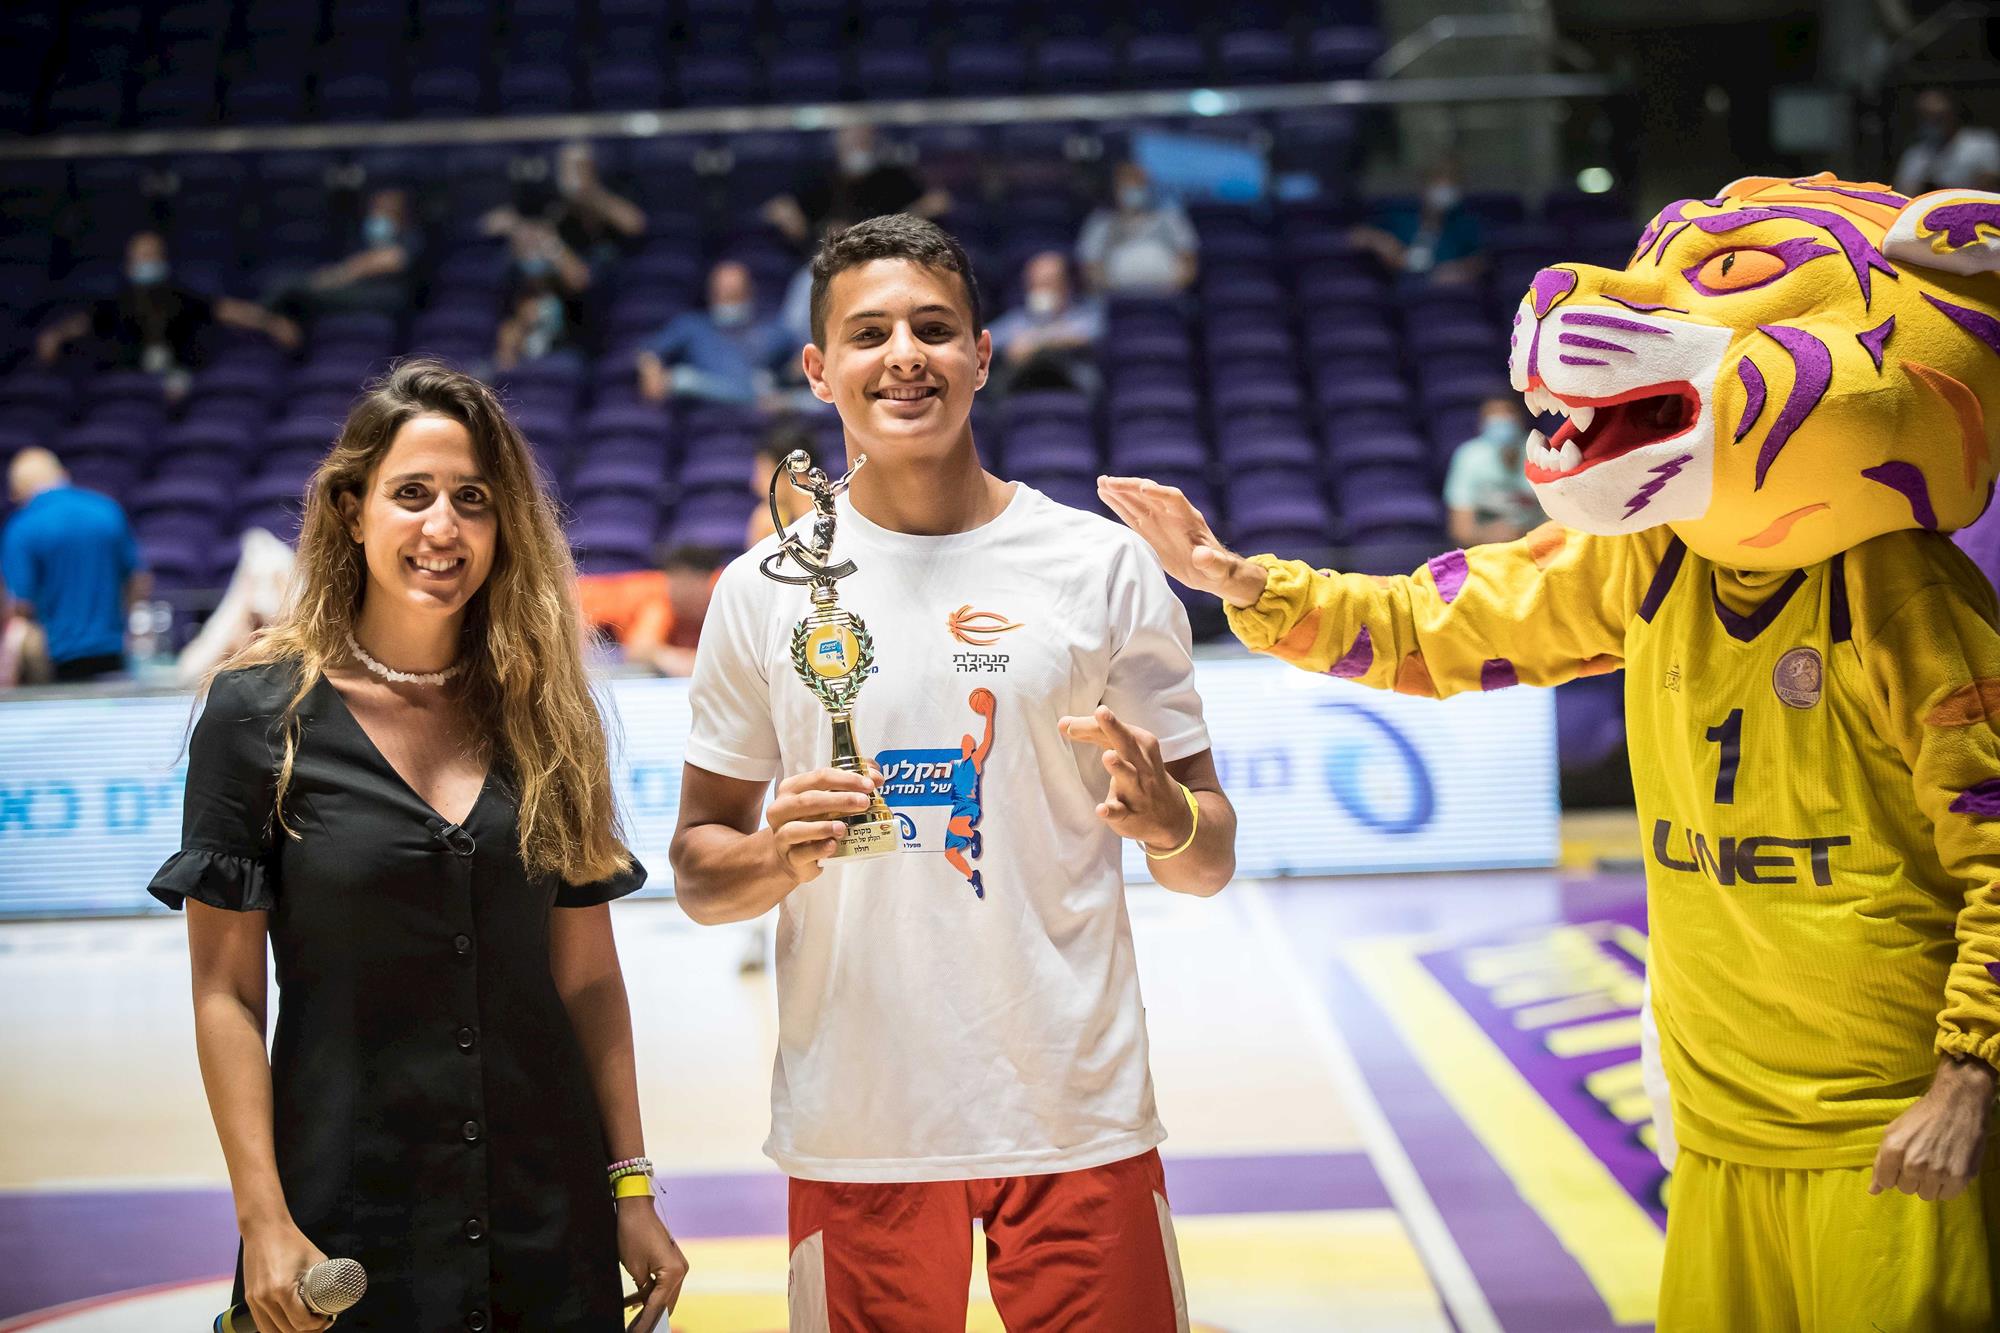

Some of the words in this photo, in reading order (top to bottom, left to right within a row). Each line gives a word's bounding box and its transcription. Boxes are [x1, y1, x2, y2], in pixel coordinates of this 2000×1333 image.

[952, 651, 1010, 663] מנהלת
[956, 661, 1006, 673] הליגה
[1705, 708, 1744, 805] 1
[882, 759, 953, 783] הקלע
[930, 781, 952, 793] של
[853, 827, 872, 836] מקום
[853, 845, 870, 854] חולון
[1652, 818, 1851, 887] UNET
